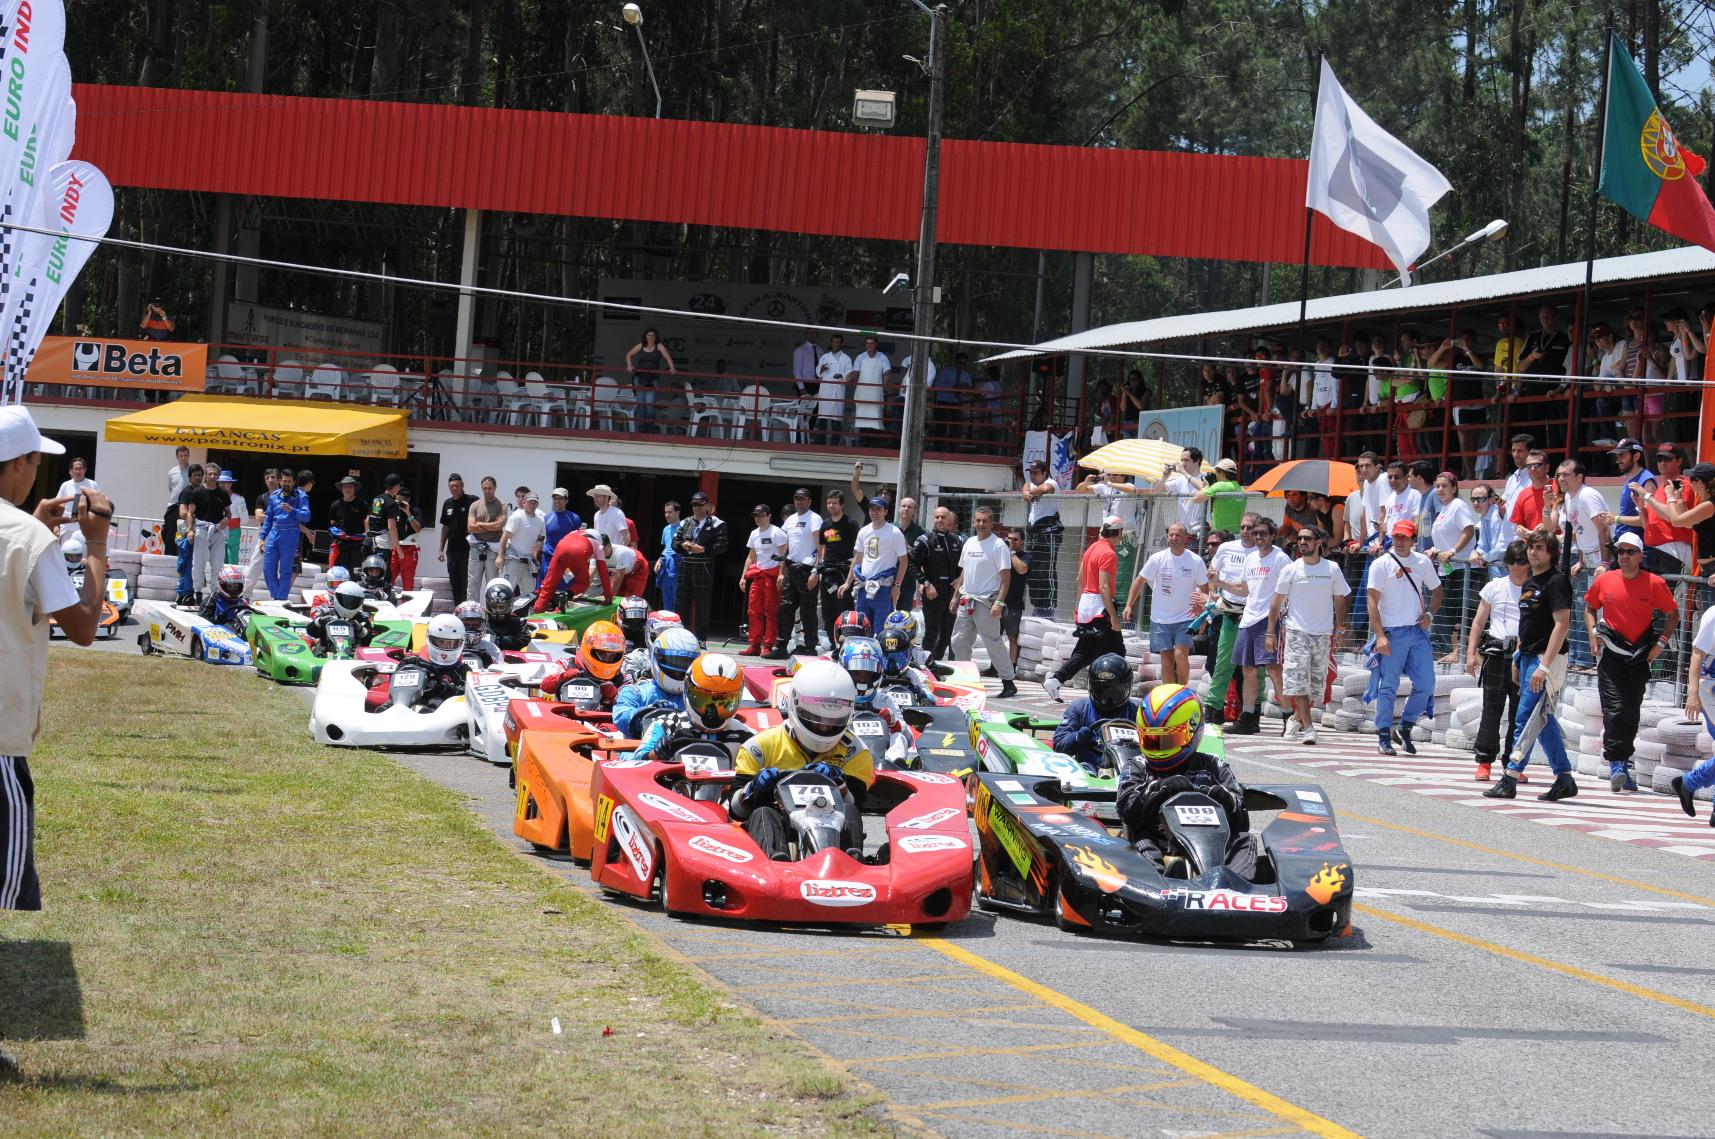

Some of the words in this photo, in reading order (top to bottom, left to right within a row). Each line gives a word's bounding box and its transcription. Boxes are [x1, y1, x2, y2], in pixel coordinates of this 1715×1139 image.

[3, 57, 26, 143] EURO
[20, 122, 37, 188] EUR
[60, 173, 84, 225] INDY
[103, 343, 183, 377] Beta
[144, 435, 312, 453] www.pestronix.pt
[165, 621, 186, 644] PMH
[689, 755, 711, 765] 17
[795, 785, 826, 796] 74
[1177, 806, 1215, 815] 109
[994, 805, 1029, 862] WARNING
[694, 836, 748, 862] liztrez
[803, 883, 874, 899] liztrez
[1185, 892, 1288, 913] RACES
